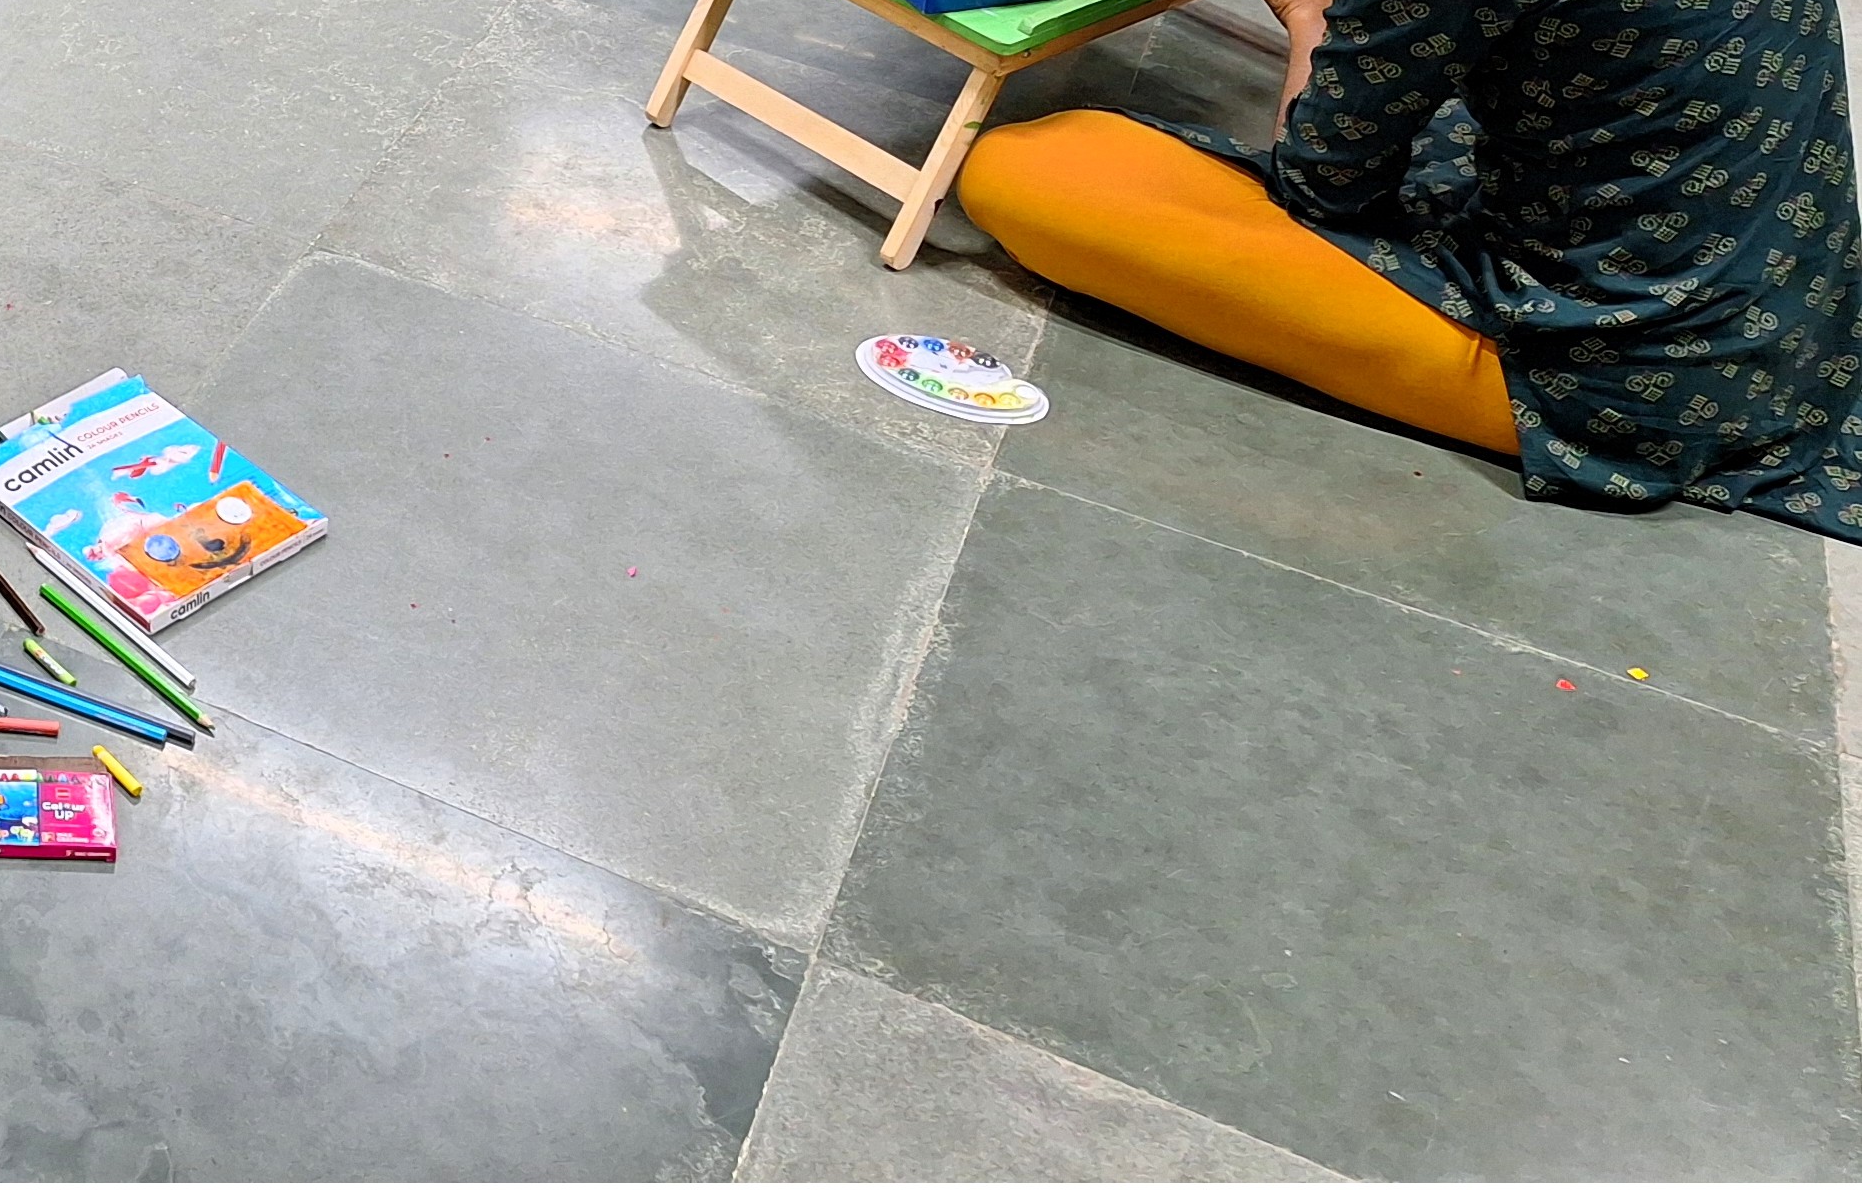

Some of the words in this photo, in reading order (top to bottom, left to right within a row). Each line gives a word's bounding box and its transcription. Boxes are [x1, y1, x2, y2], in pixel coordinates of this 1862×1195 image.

[4, 443, 84, 492] camlin
[77, 421, 118, 442] COLOUR
[118, 402, 160, 424] PENCILS
[170, 590, 210, 620] camlin
[54, 809, 75, 821] UP
